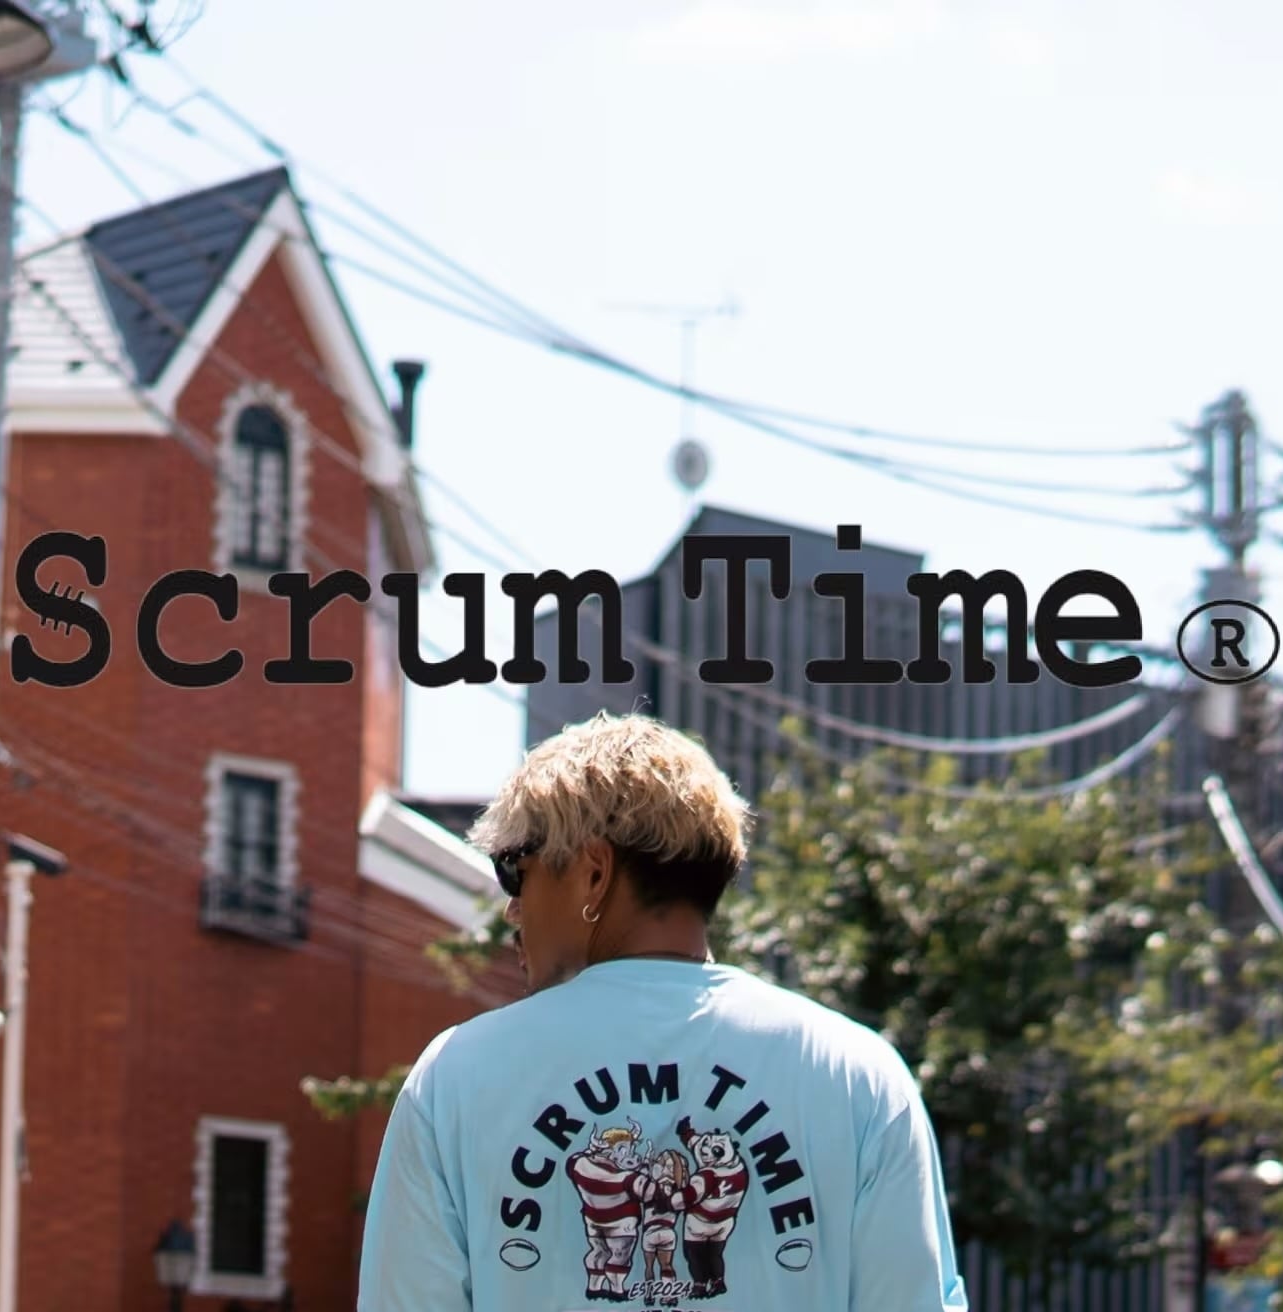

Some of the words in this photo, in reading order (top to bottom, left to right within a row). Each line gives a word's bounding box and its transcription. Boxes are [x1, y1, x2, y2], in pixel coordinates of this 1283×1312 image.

[500, 1062, 680, 1233] SCRUM
[704, 1064, 816, 1236] TIME
[652, 1280, 691, 1297] 2024
